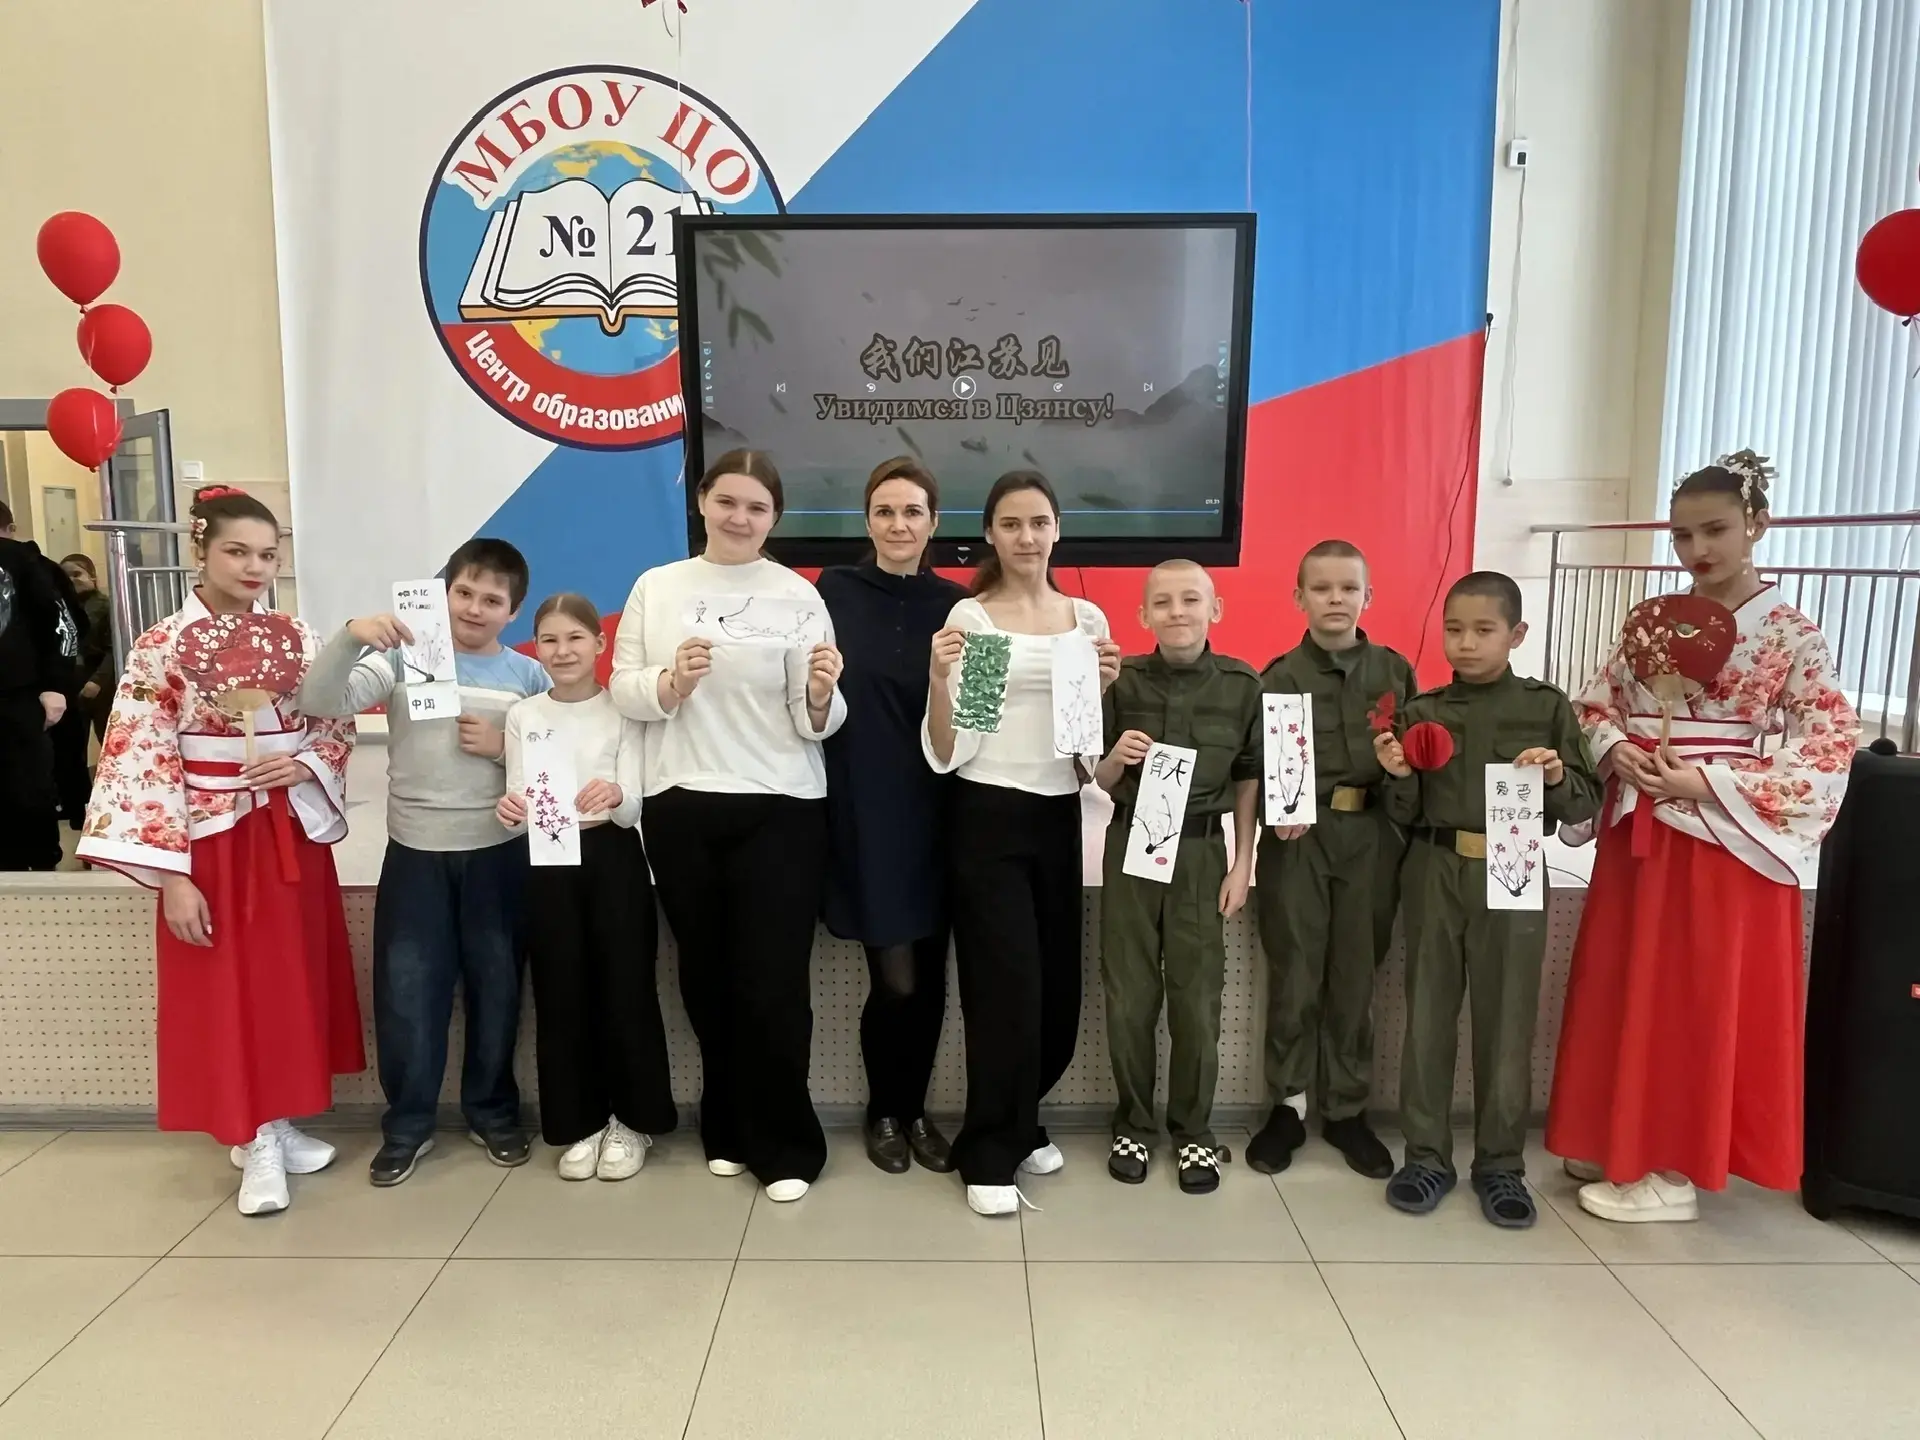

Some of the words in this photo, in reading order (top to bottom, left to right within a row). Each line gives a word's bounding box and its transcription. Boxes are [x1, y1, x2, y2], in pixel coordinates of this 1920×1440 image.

[451, 80, 645, 201] МБОУ
[657, 100, 751, 196] ЦО
[539, 214, 596, 258] №
[465, 329, 532, 403] Центр
[532, 393, 684, 431] образовани
[860, 333, 1070, 383] 我们江苏见
[813, 393, 969, 425] Увидимся
[972, 399, 991, 419] в
[996, 392, 1115, 426] Цзянсу!
